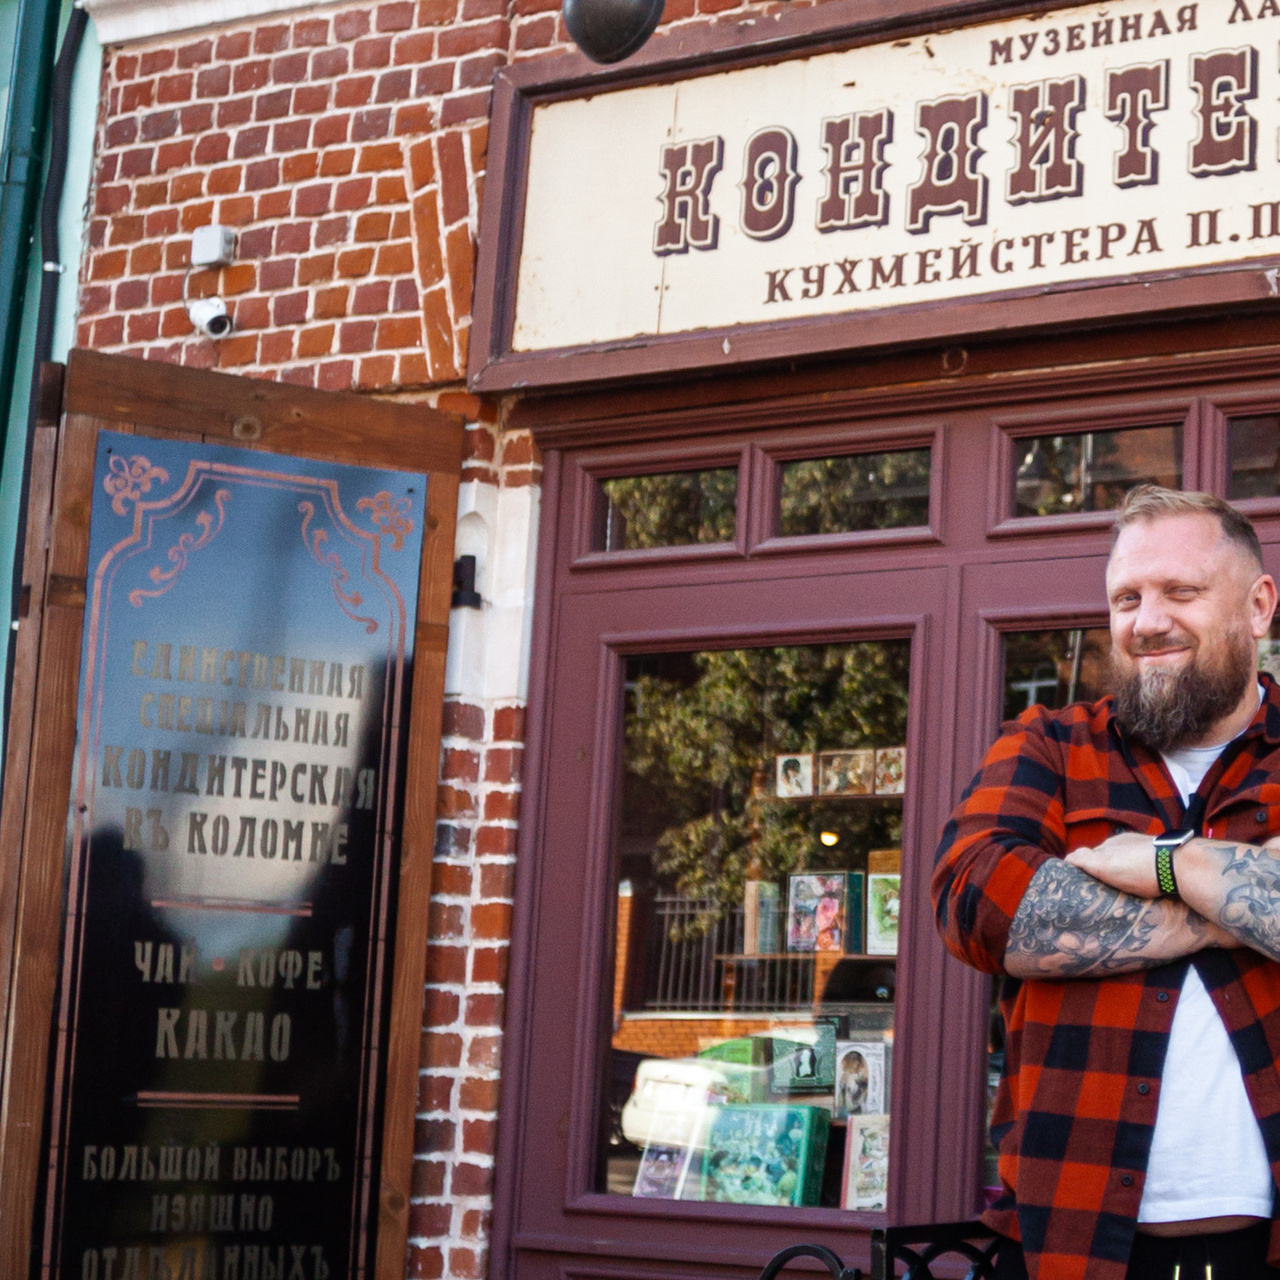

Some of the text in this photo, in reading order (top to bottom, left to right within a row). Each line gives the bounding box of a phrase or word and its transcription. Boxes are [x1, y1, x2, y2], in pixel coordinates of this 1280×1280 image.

[989, 3, 1198, 66] МУЗЕЙНАЯ
[764, 219, 1163, 305] КУХМЕЙСТЕРА
[131, 641, 366, 702] ЕДИНСТВЕННАЯ
[102, 745, 376, 811] КОНДИТЕРСКАЯ
[236, 947, 324, 991] КОФЕ
[155, 1007, 292, 1063] КАКАО
[82, 1138, 341, 1182] БОЛЬШОЙ ВЫБОРЪ
